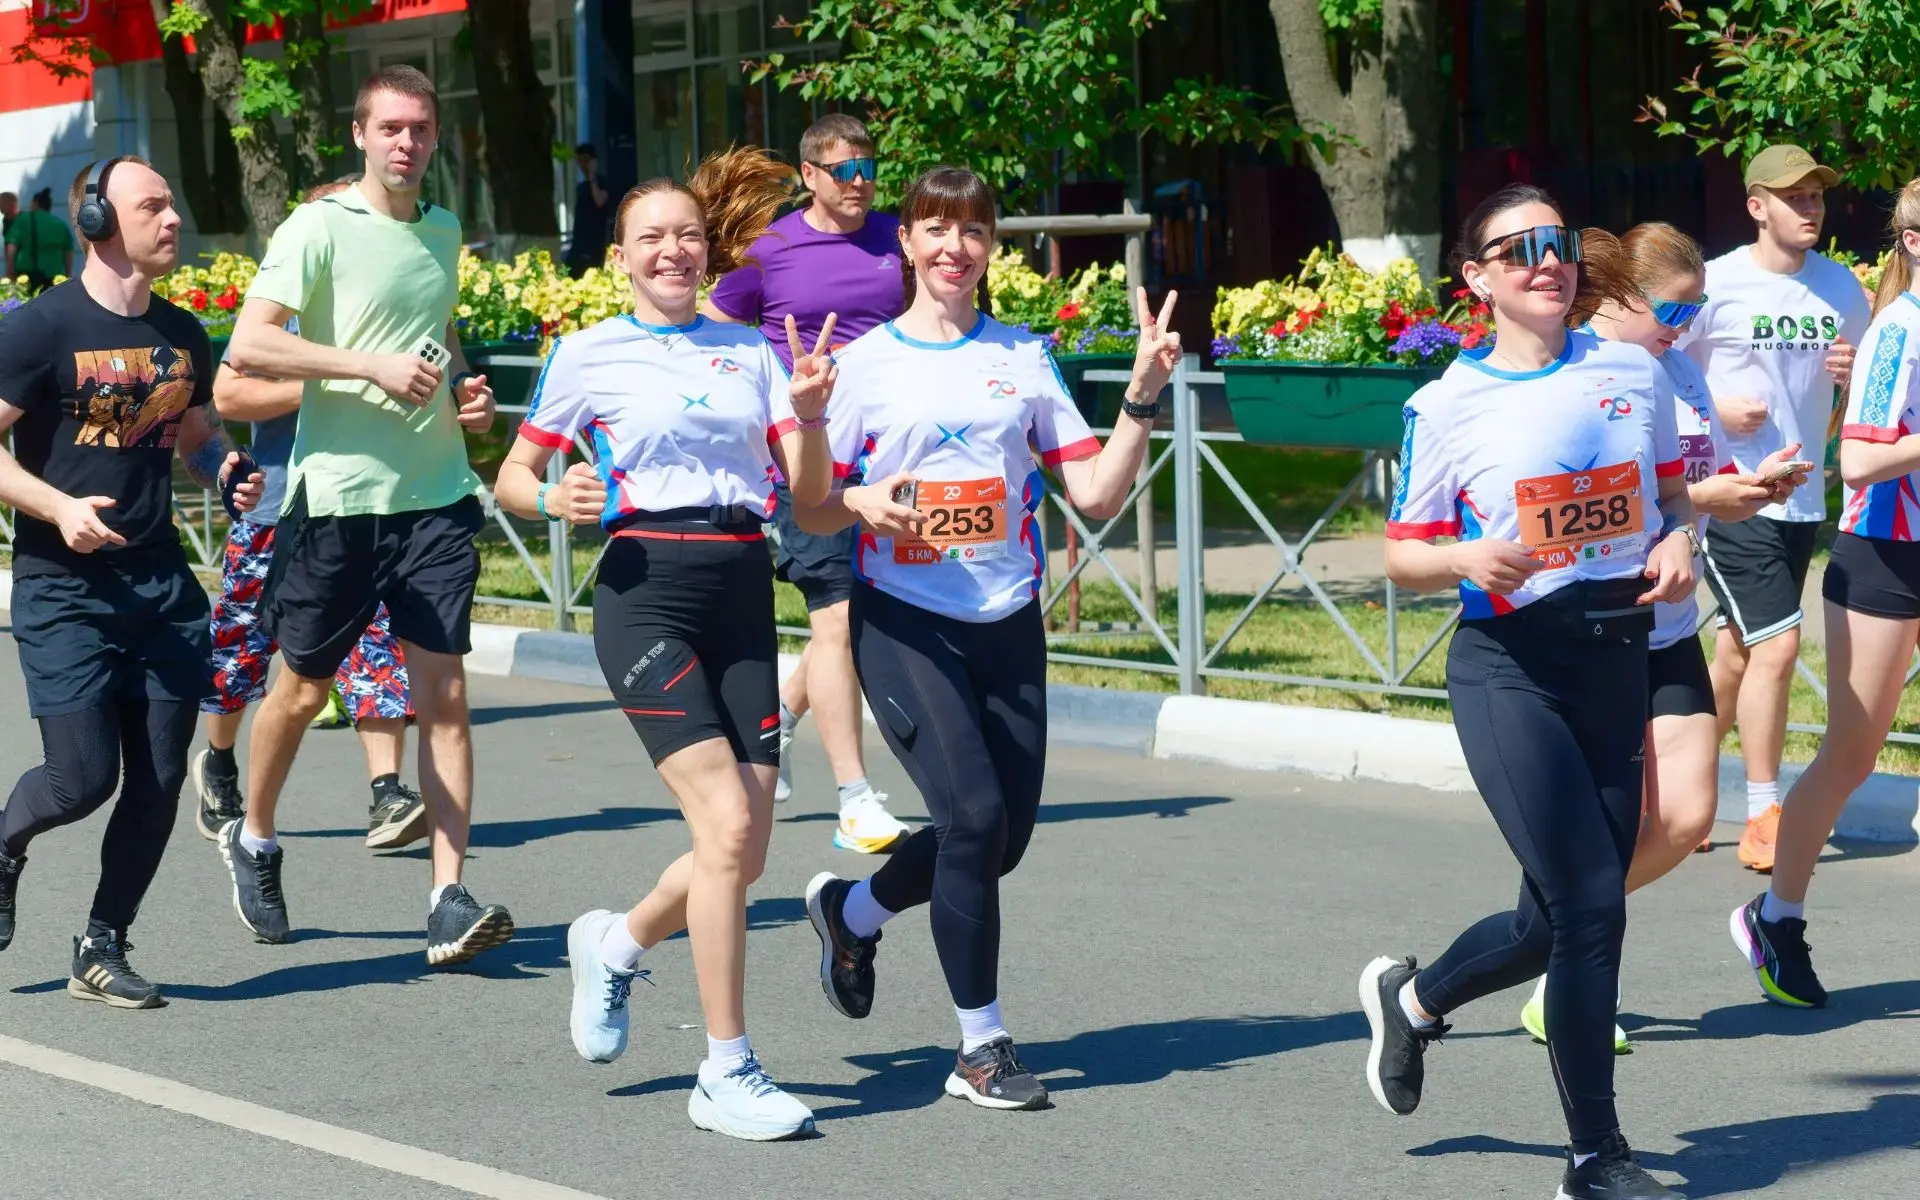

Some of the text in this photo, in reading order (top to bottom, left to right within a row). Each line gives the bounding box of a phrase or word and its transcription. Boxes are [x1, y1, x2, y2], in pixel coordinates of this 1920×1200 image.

[1751, 315, 1838, 340] BOSS
[1600, 397, 1631, 421] 20
[944, 485, 962, 500] 20
[1573, 476, 1592, 494] 20
[1536, 494, 1630, 538] 1258
[917, 549, 932, 560] KM
[1548, 551, 1566, 565] KM
[632, 656, 650, 674] THE
[648, 641, 666, 657] TOP
